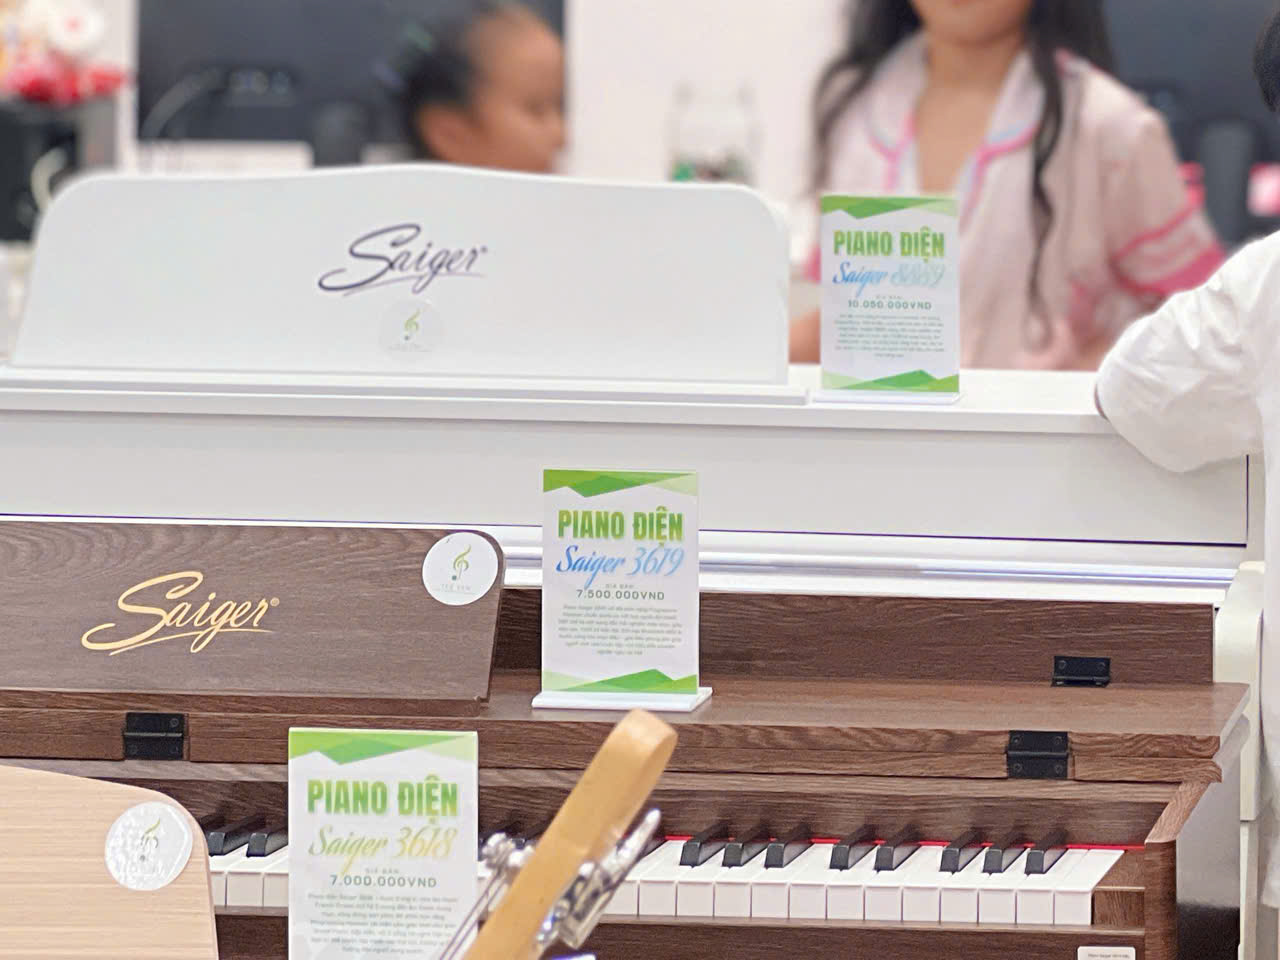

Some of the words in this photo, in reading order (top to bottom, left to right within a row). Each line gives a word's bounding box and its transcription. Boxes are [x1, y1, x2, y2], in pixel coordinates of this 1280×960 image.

[318, 223, 486, 296] Saiger
[833, 229, 892, 256] PIANO
[832, 261, 888, 298] Saiger
[557, 509, 625, 539] PIANO
[632, 505, 684, 547] ĐIỆN
[556, 545, 626, 590] Saiger
[627, 546, 686, 577] 3619
[81, 571, 272, 655] Saiger
[577, 589, 665, 601] 7.500.000VND
[307, 779, 388, 815] PIANO
[397, 774, 459, 825] ĐIỆN
[308, 825, 388, 876] Saiger
[330, 874, 438, 888] 7.000.000VND
